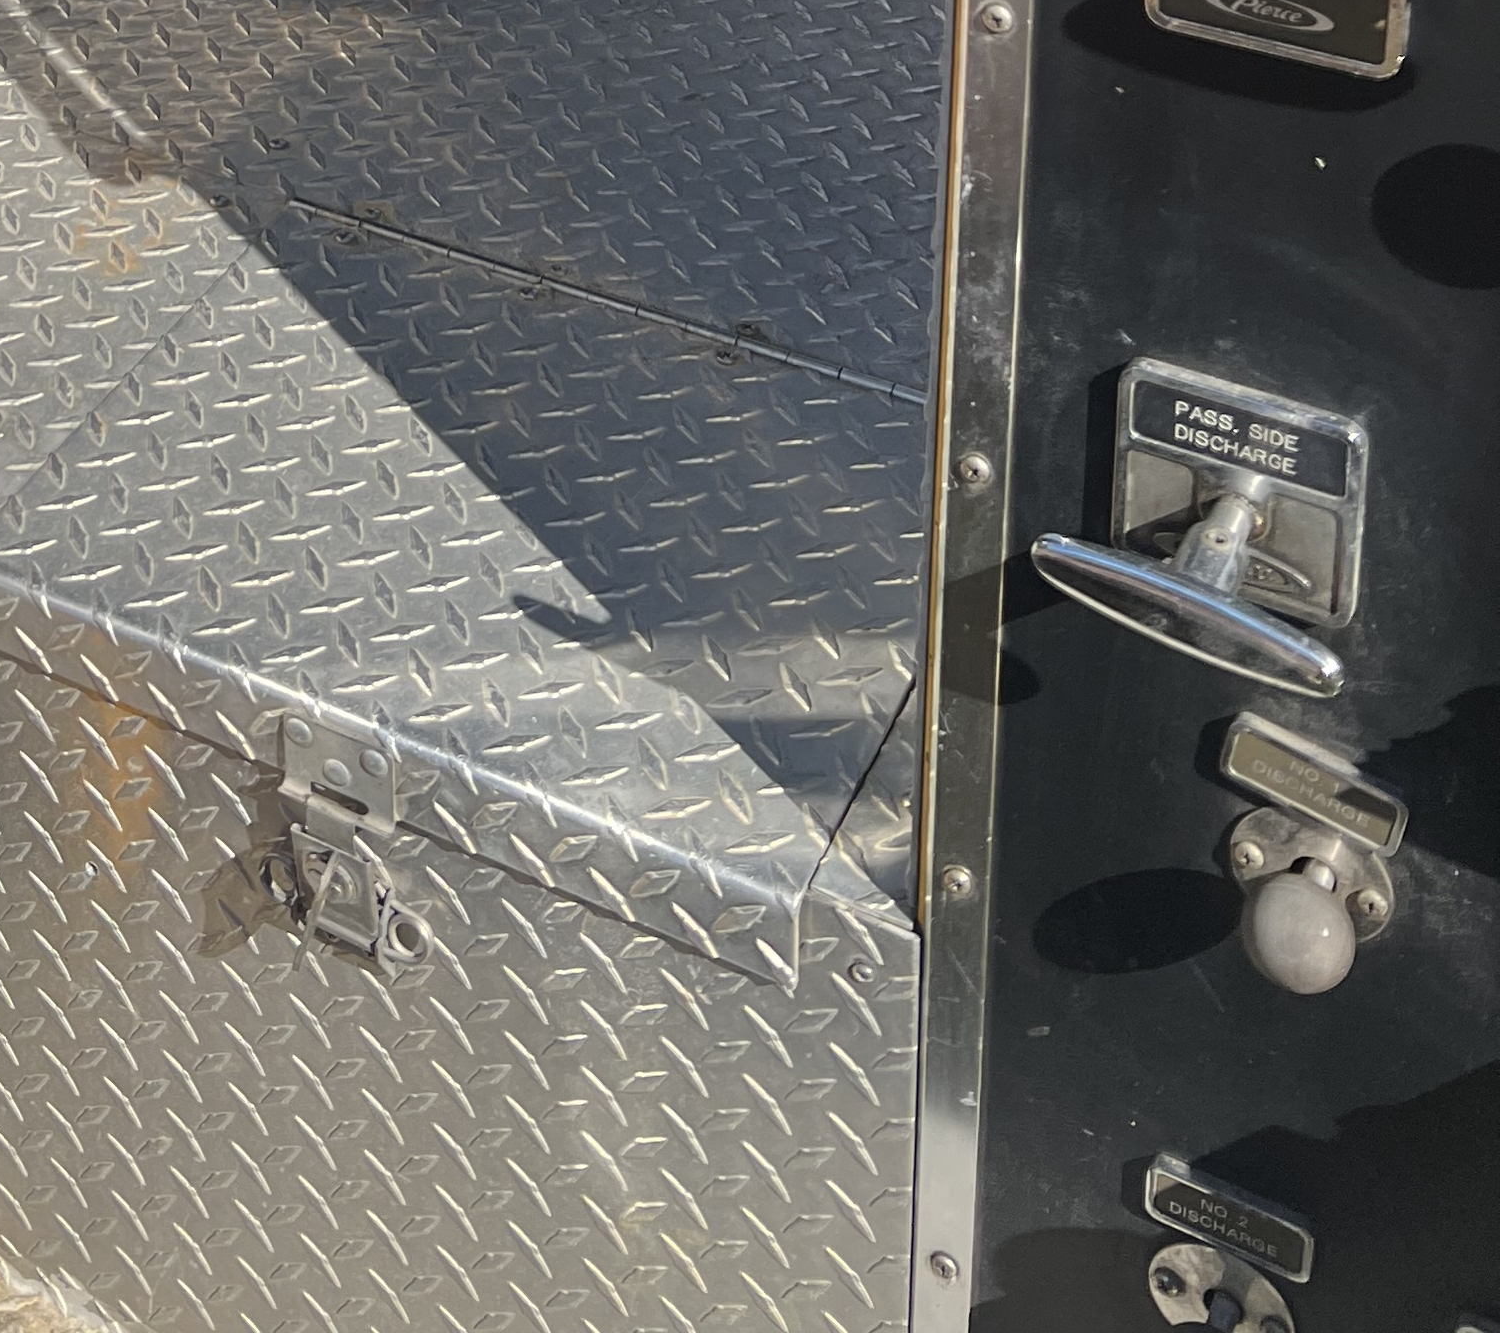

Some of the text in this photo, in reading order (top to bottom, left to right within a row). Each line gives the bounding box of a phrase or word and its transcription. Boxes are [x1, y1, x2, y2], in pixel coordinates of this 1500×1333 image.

[1174, 400, 1300, 452] PASS. SIDE
[1174, 423, 1298, 476] DISCHARGE
[1252, 759, 1372, 828] DISCHARGE
[1169, 1201, 1278, 1258] DISCHARGE
[1237, 1215, 1249, 1229] 2
